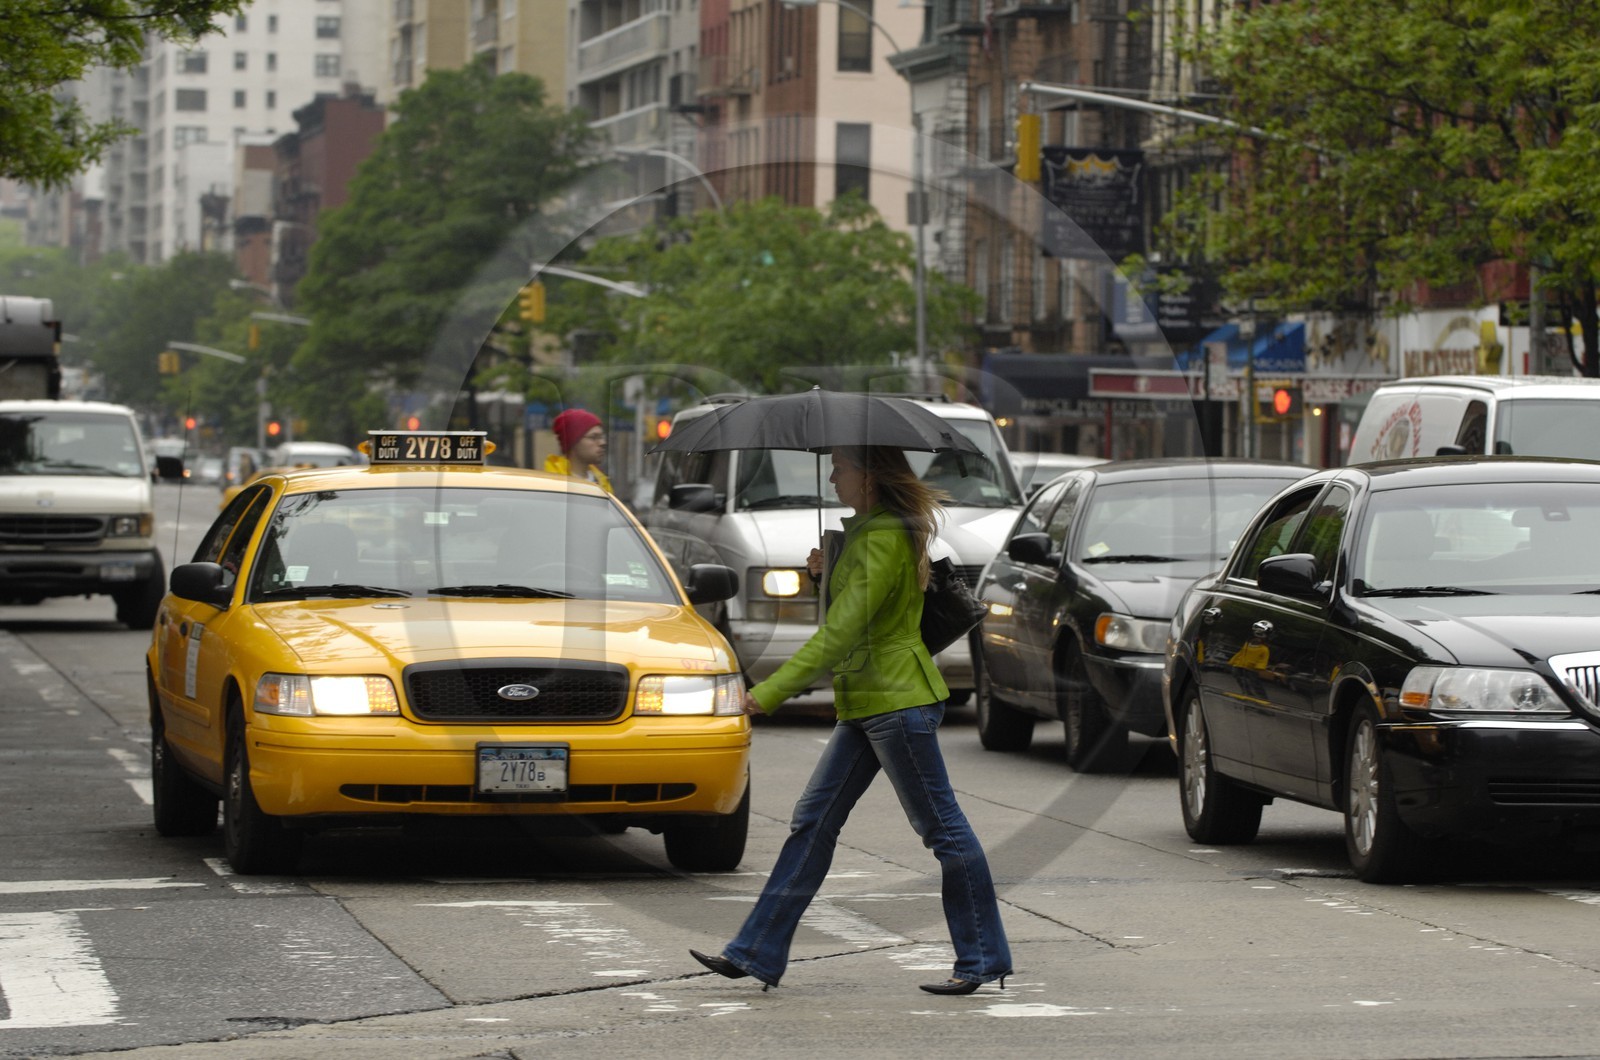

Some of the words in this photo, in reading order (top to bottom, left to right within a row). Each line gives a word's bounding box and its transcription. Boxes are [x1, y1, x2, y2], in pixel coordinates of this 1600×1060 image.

[381, 436, 397, 447] OFF
[459, 436, 476, 447] OFF
[378, 447, 400, 459] DUTY
[406, 436, 452, 459] 2Y78
[456, 448, 477, 459] DUTY
